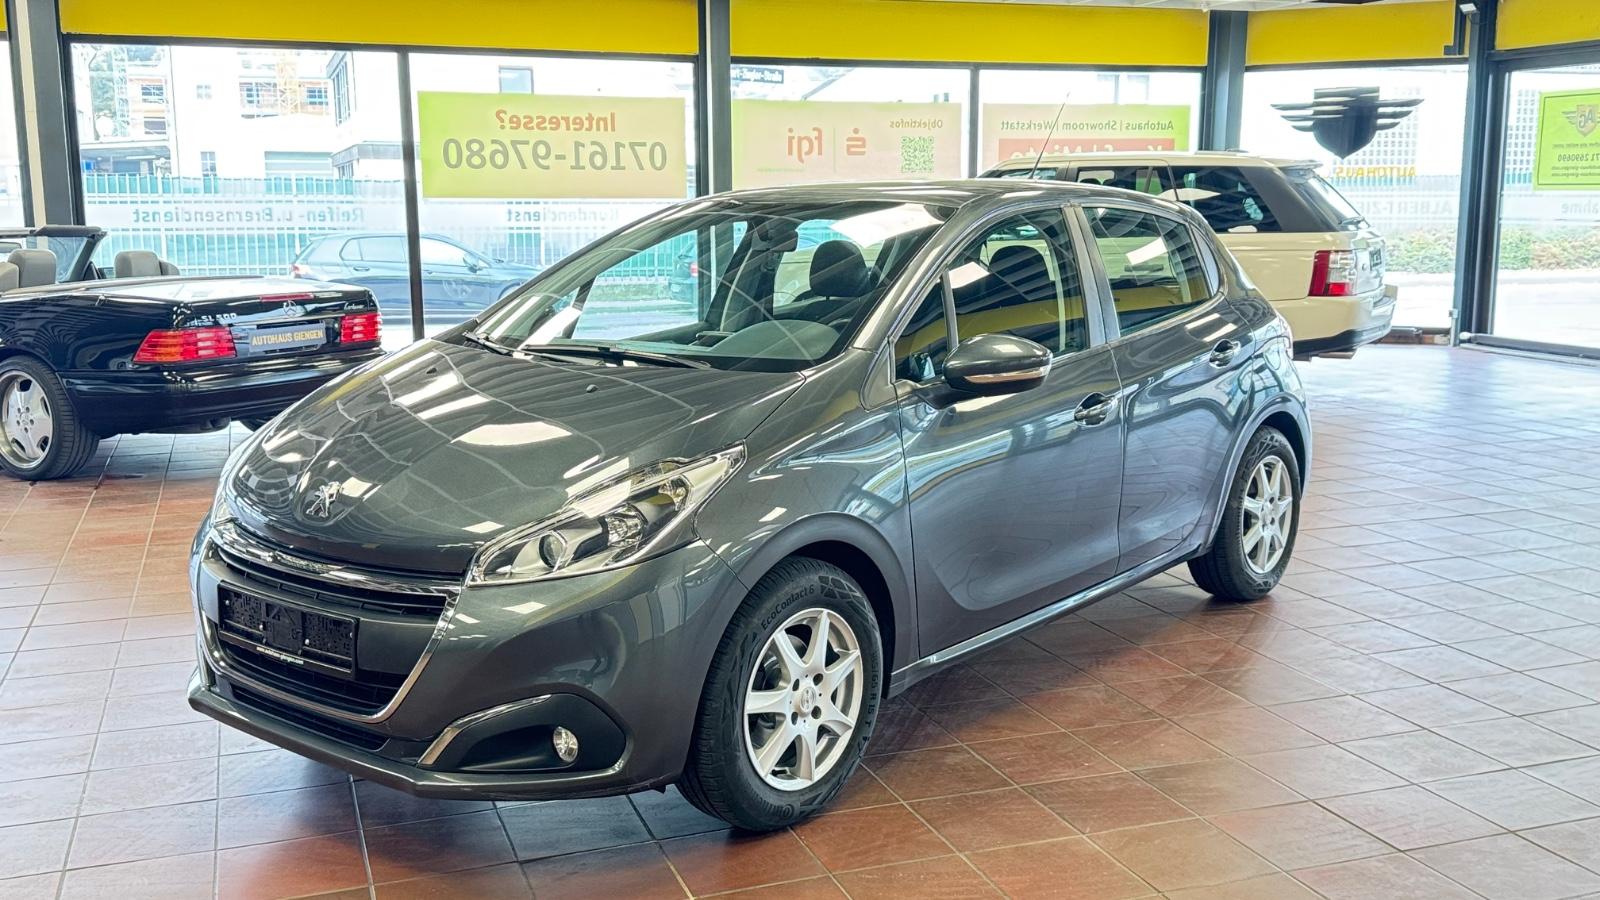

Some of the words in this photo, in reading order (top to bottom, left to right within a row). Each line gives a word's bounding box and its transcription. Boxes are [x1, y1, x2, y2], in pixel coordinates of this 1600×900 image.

[252, 332, 293, 346] AUTOHAUS
[294, 329, 324, 343] GIENGEN
[761, 587, 809, 631] EcoContact
[808, 584, 815, 594] 6
